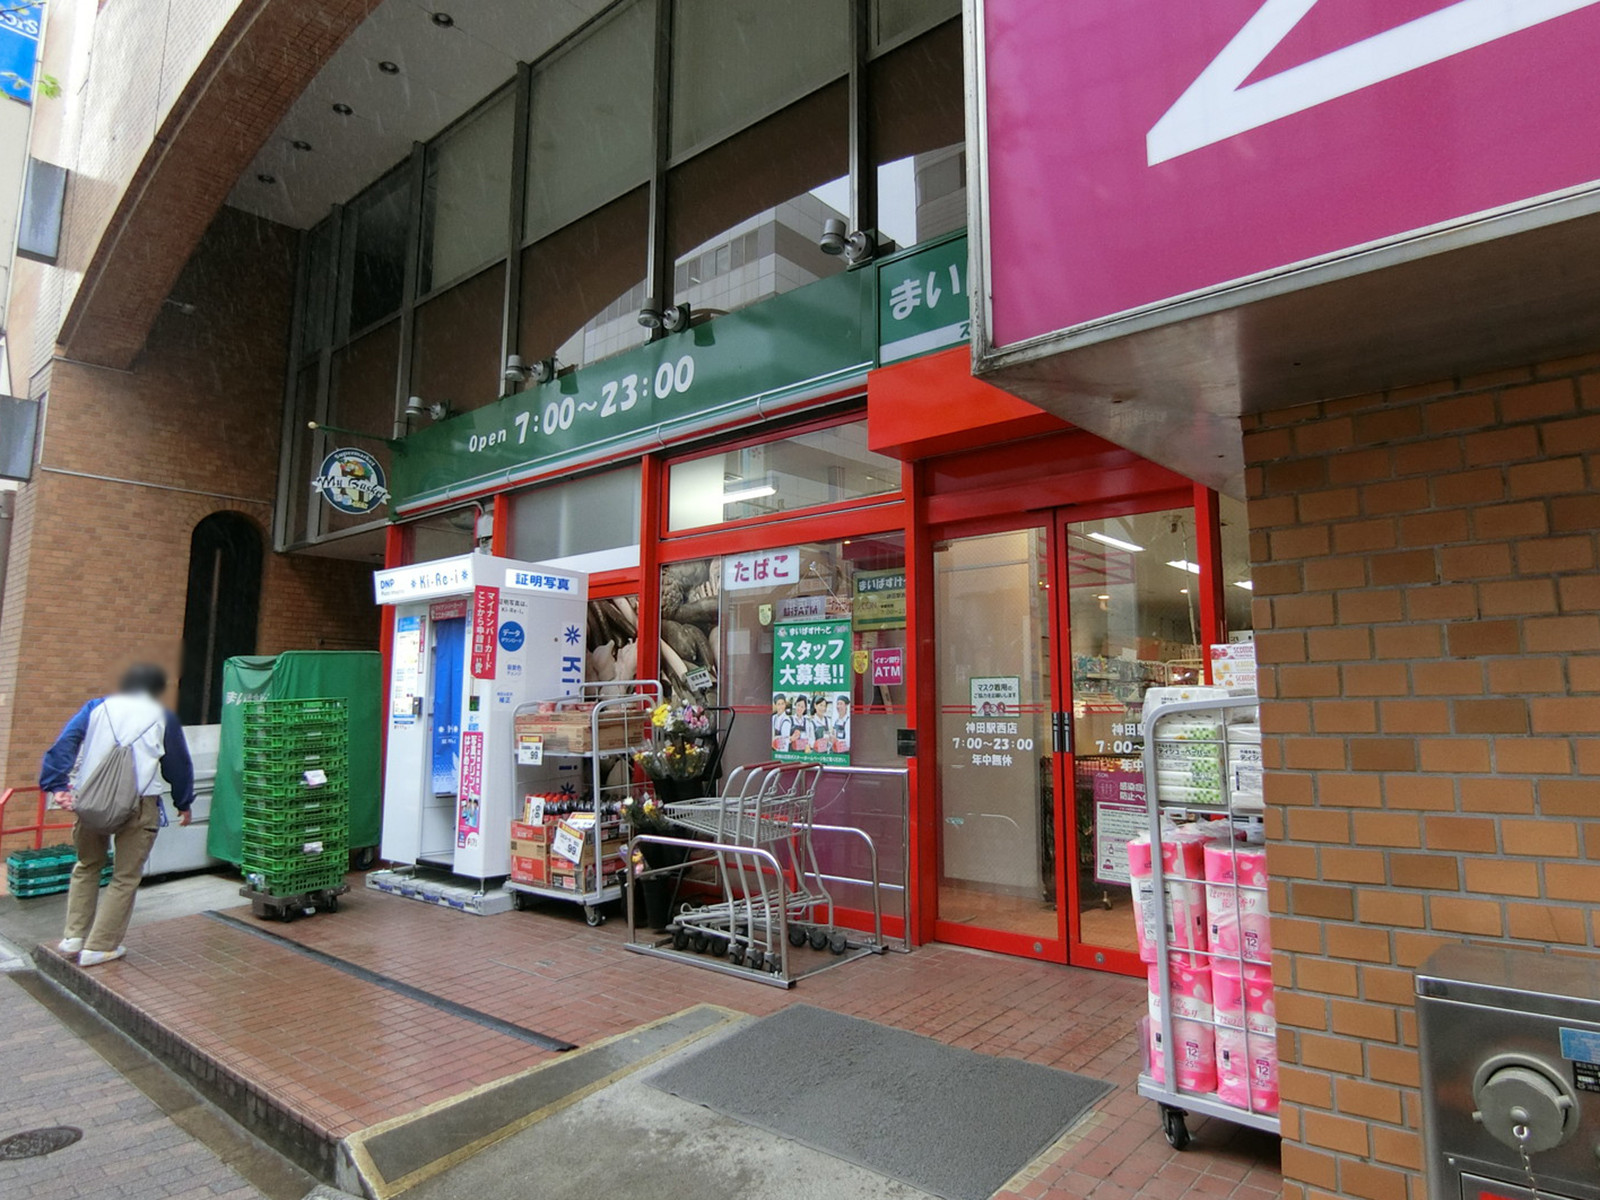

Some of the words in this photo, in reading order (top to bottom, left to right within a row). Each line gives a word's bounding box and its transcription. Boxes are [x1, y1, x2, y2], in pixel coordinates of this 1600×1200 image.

[468, 428, 507, 452] Open
[334, 451, 375, 466] Supermarket
[734, 555, 789, 582] たばこ
[380, 578, 395, 589] DNP
[515, 572, 570, 591] 証明写真
[858, 575, 905, 591] まいばすけ
[789, 625, 832, 636] まいばすけっと
[780, 639, 844, 661] スタッフ
[780, 663, 844, 685] 大募集!!
[875, 666, 900, 677] ATM
[978, 683, 1012, 692] マスク着用の
[965, 722, 1018, 734] 神田駅西店
[971, 753, 1013, 767] 年中無休
[1187, 1047, 1198, 1057] 12
[1257, 1065, 1269, 1076] 12
